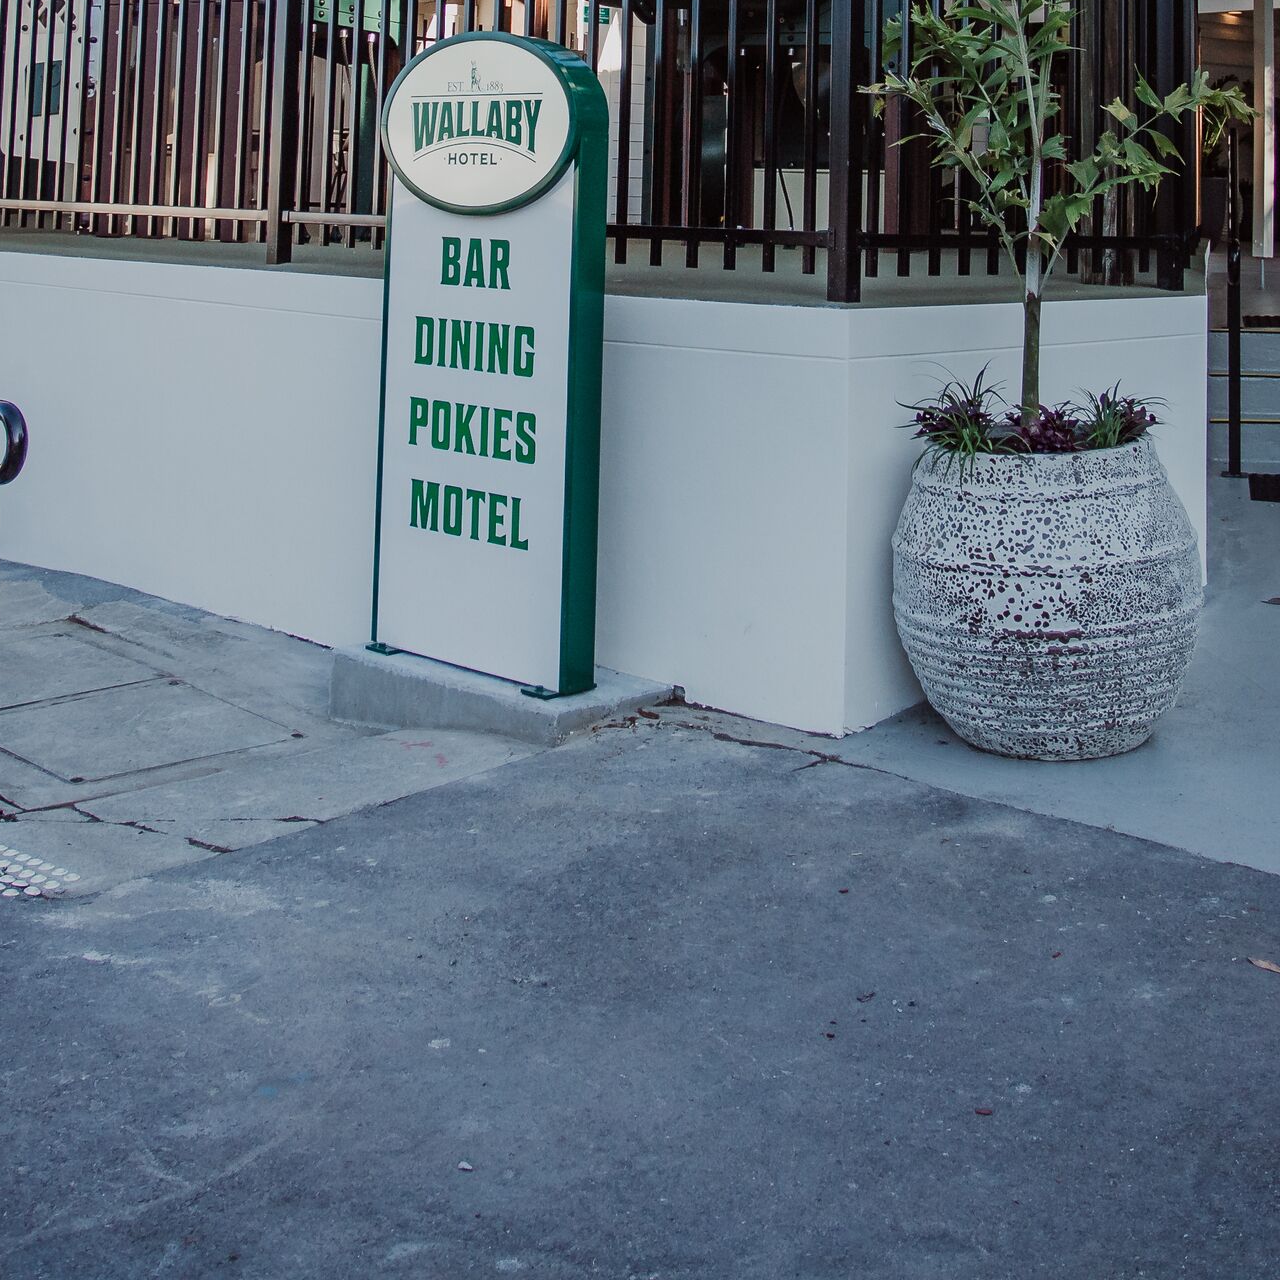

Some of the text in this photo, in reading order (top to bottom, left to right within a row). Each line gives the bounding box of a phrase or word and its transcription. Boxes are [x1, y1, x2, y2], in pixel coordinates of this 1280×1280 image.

[486, 81, 504, 94] 1883
[412, 99, 542, 154] WALLABY
[448, 153, 497, 166] HOTEL
[441, 236, 511, 290] BAR
[414, 316, 535, 378] DINING
[408, 396, 536, 465] POKIES
[410, 478, 528, 551] MOTEL
